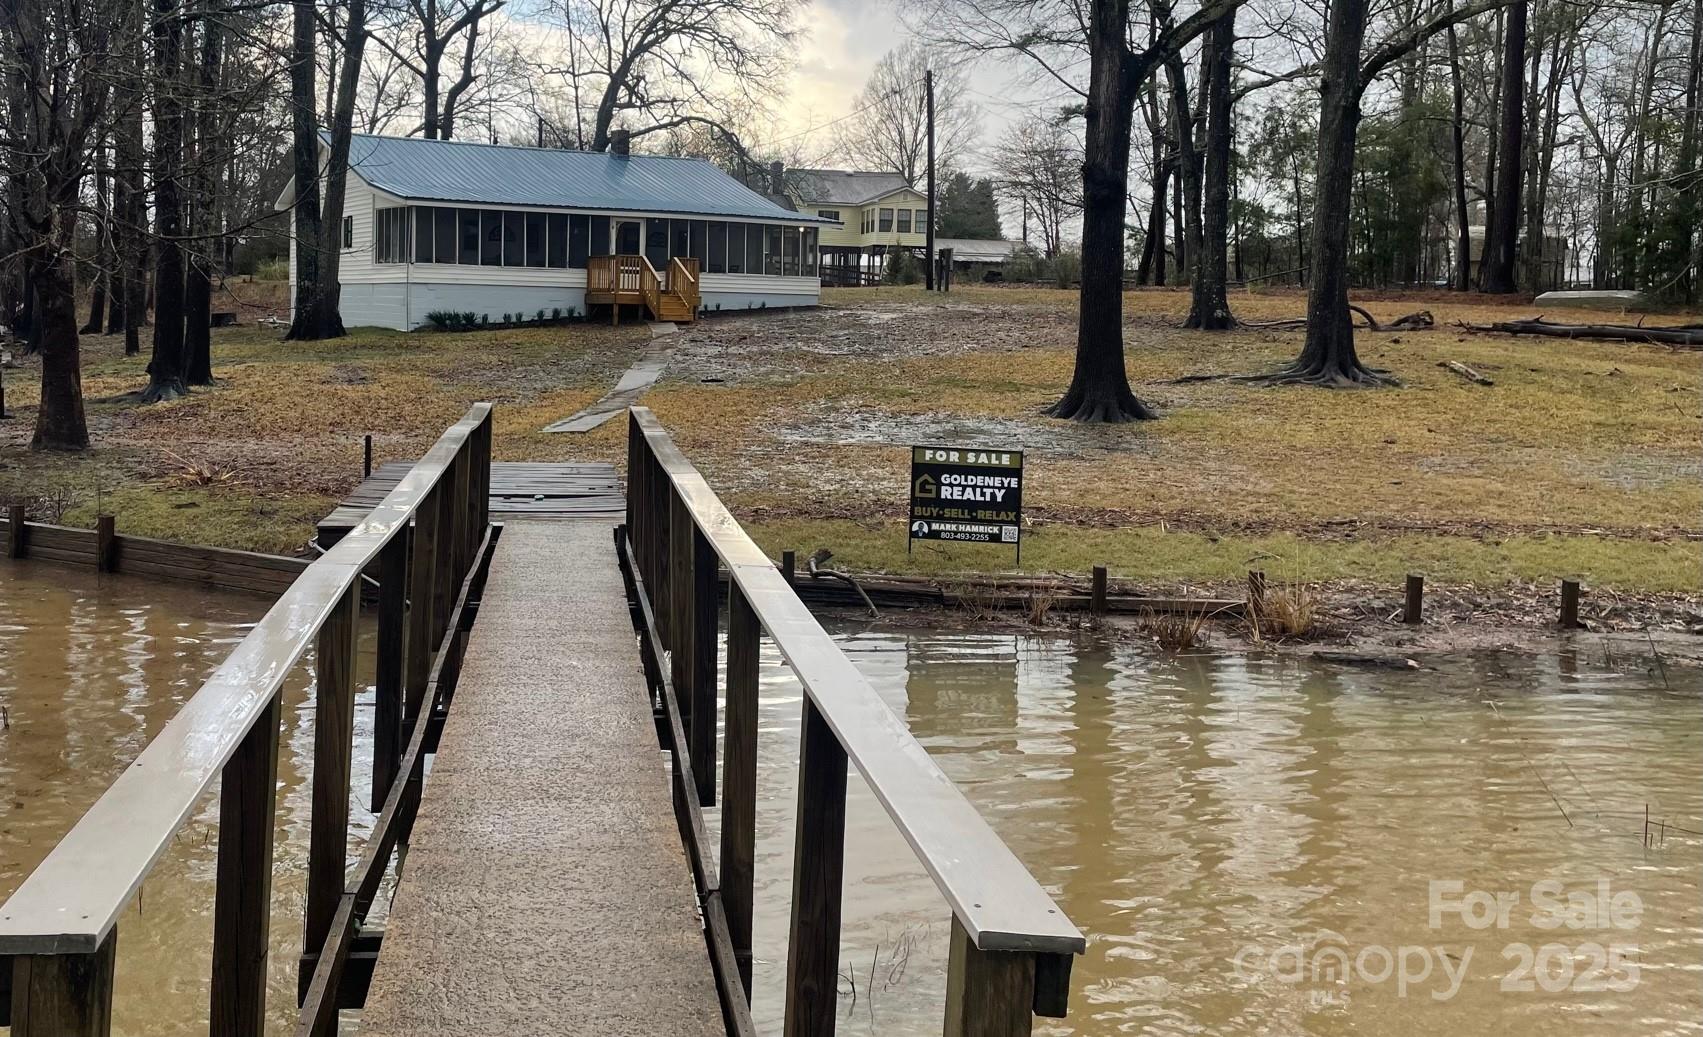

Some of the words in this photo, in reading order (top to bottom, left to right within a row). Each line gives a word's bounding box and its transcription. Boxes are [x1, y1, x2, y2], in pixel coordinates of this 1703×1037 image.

[925, 450, 959, 462] FOR
[967, 452, 1010, 465] SALE
[941, 474, 1018, 488] GOLDENEYE
[941, 486, 1006, 502] REALTY
[931, 523, 957, 532] MARK
[959, 524, 1000, 534] HAMRICK
[940, 531, 989, 541] 803-493-2255
